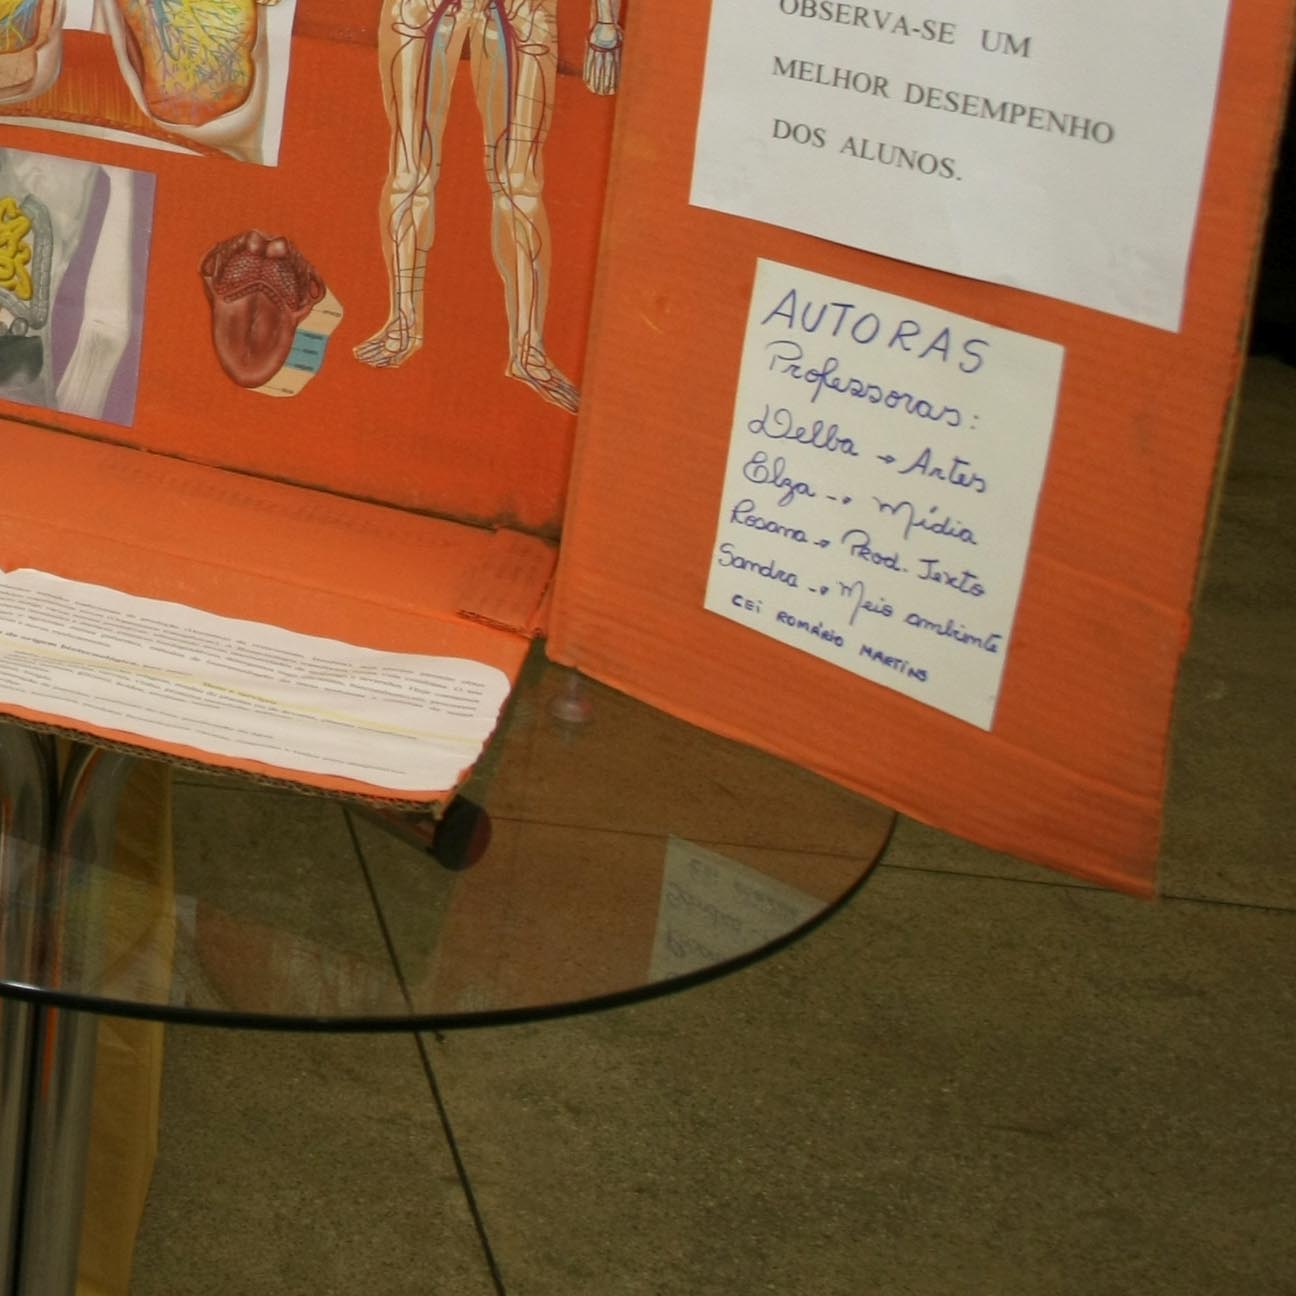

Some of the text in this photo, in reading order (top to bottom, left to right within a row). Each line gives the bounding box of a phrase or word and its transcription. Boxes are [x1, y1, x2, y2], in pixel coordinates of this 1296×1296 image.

[981, 28, 1032, 59] UM
[773, 55, 1115, 145] MELHOR DESEMPENHO
[772, 118, 961, 181] DOS ALUNOS.
[761, 289, 991, 374] AUTORAS
[898, 447, 987, 493] Artes
[717, 542, 799, 588] Sandra
[918, 557, 986, 598] Texto
